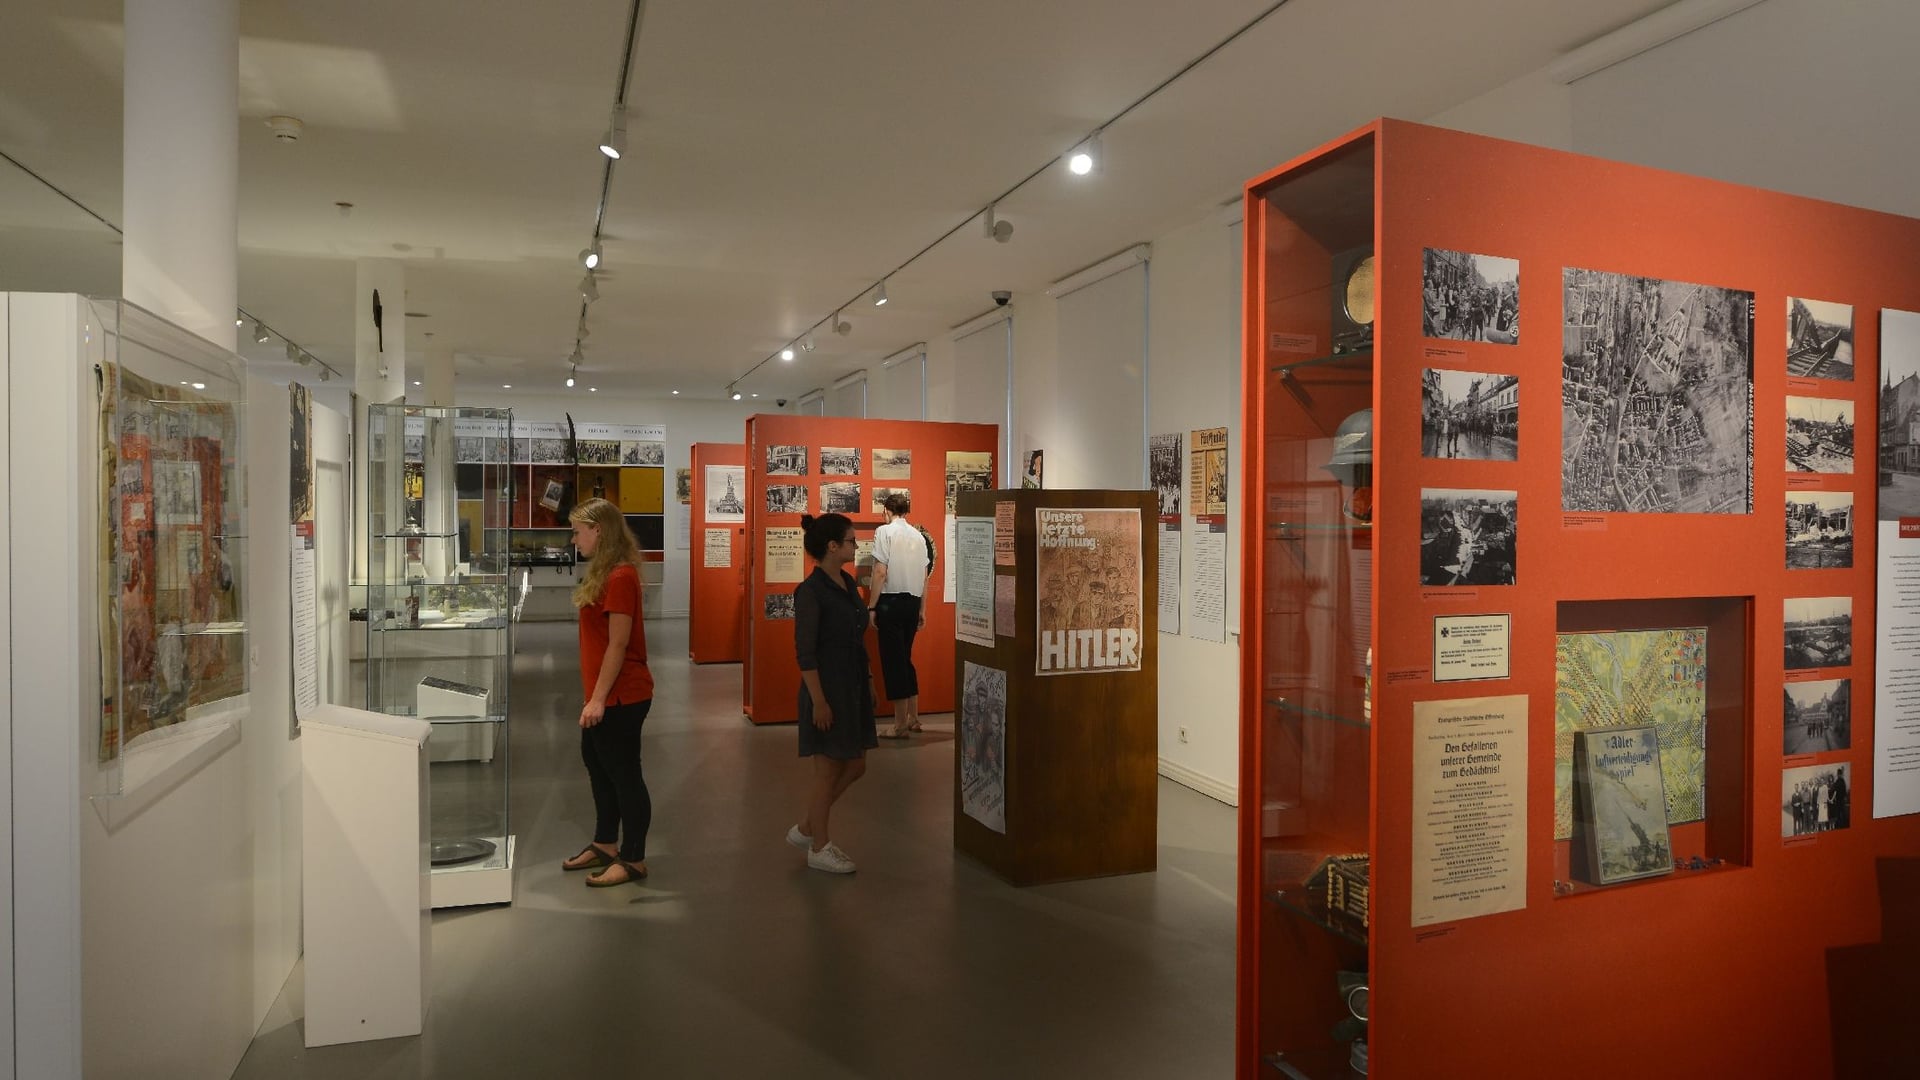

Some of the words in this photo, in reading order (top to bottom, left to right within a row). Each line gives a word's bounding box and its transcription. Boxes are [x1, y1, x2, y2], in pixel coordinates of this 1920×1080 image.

[1041, 511, 1083, 523] Unsere
[1040, 535, 1100, 550] Hoffnung:
[1041, 628, 1138, 670] HITLER
[1445, 743, 1460, 753] Den
[1461, 741, 1498, 753] Gefallenen
[1440, 756, 1466, 767] unserer
[1467, 752, 1502, 764] Gemeinde
[1442, 769, 1458, 779] zum
[1460, 764, 1500, 777] Gedächtnis!
